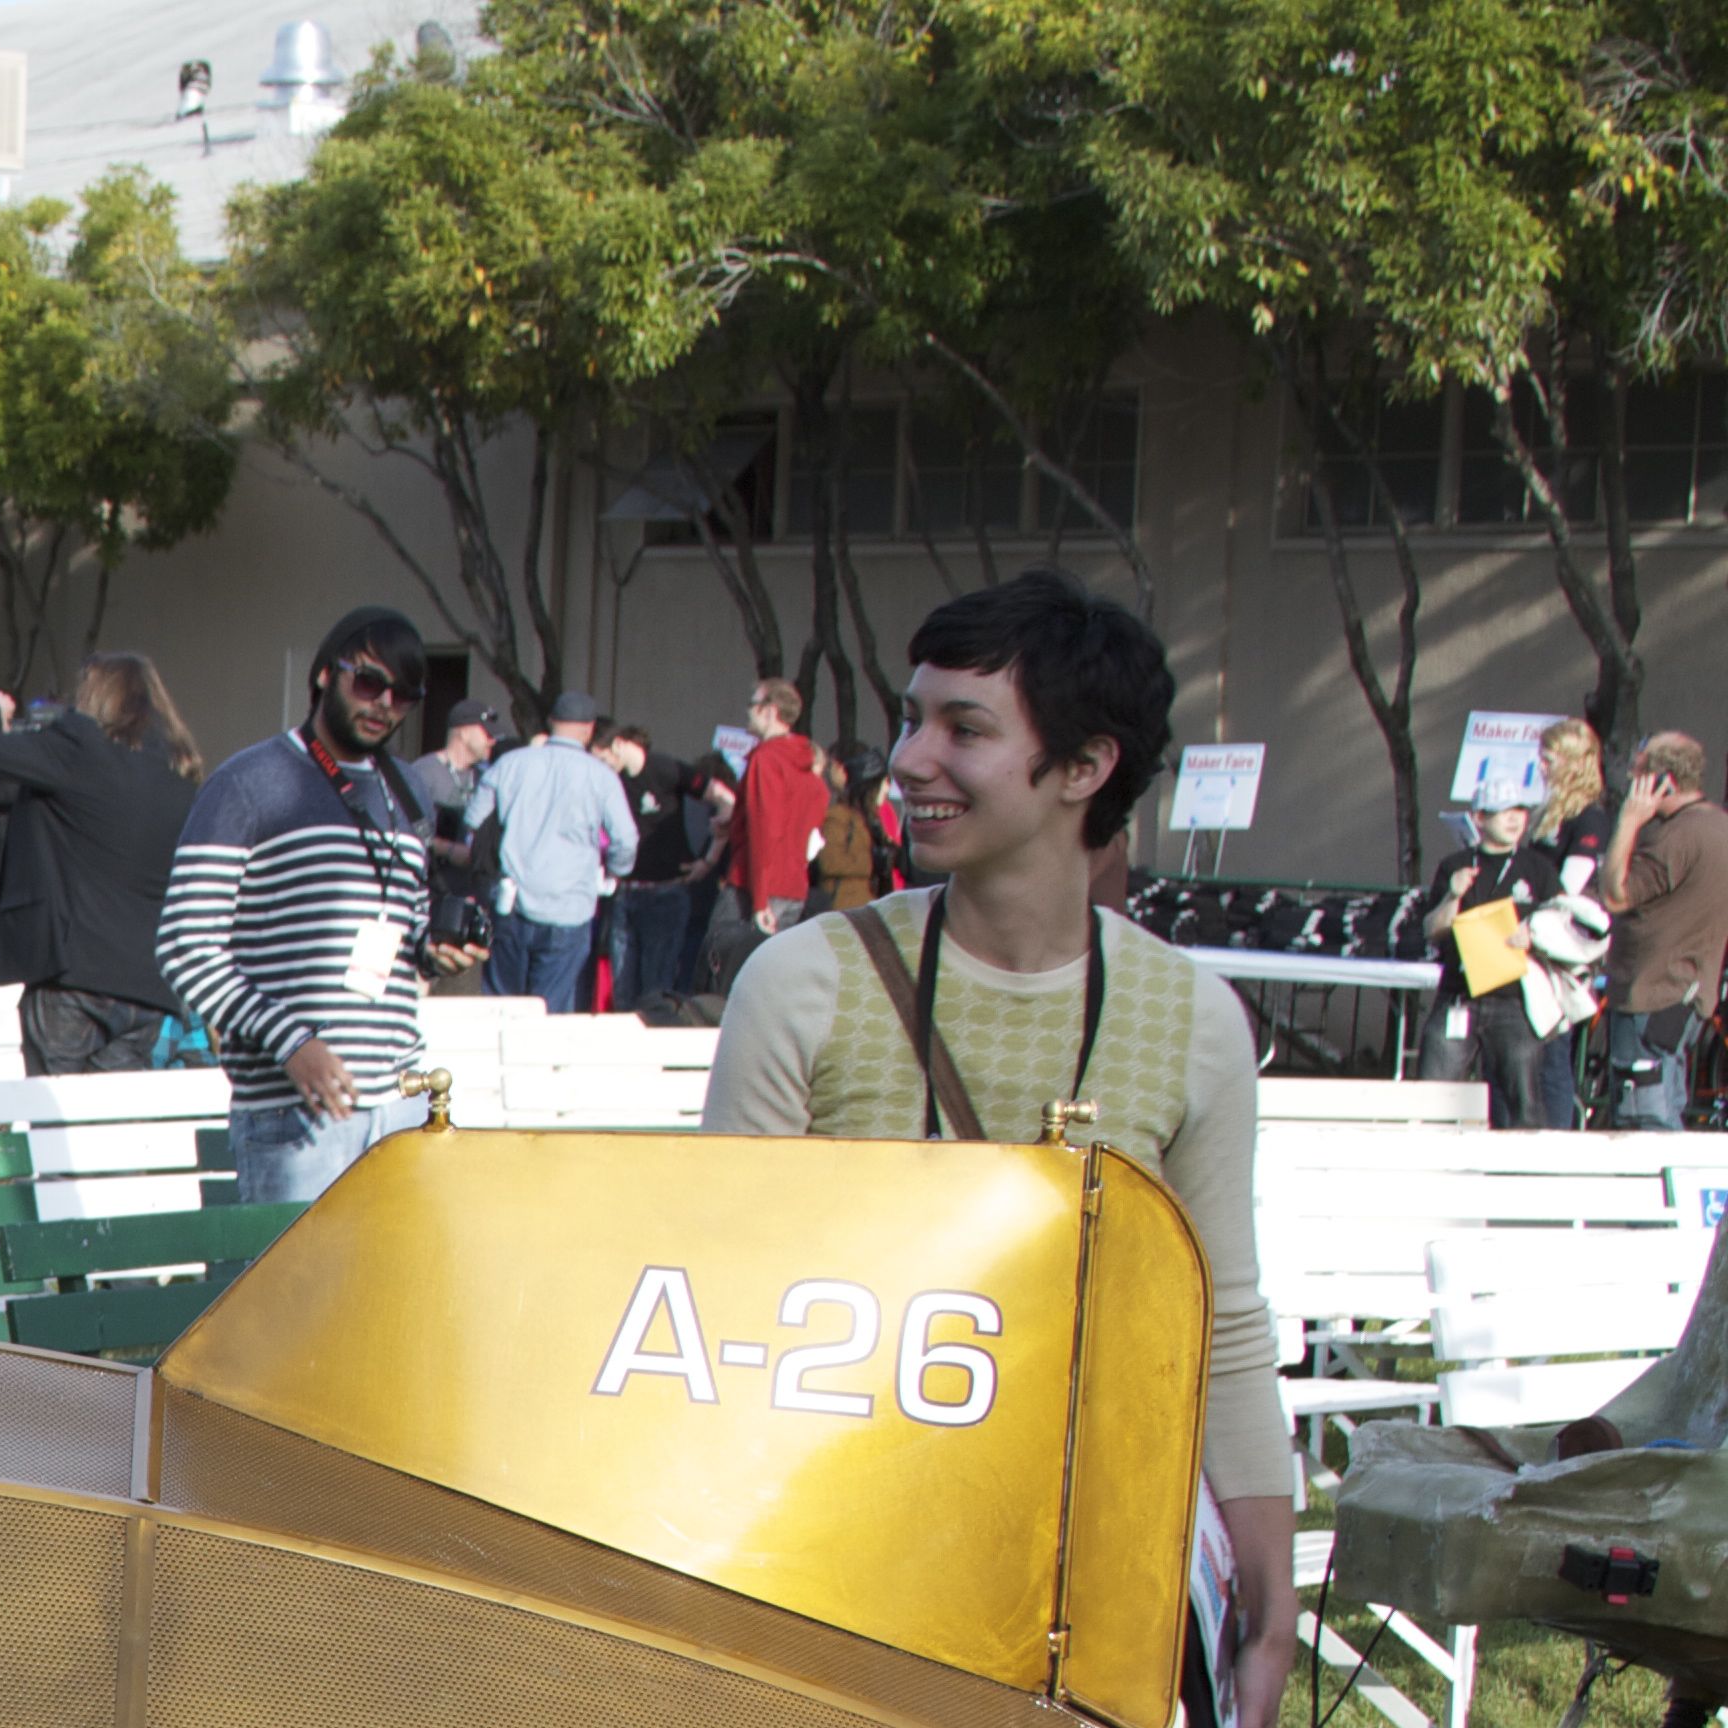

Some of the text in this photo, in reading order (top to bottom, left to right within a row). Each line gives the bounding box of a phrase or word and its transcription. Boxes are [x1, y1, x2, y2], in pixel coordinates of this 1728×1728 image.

[1473, 722, 1518, 738] Maker
[1186, 752, 1255, 769] Maker Faire
[590, 1264, 1003, 1428] A-26
